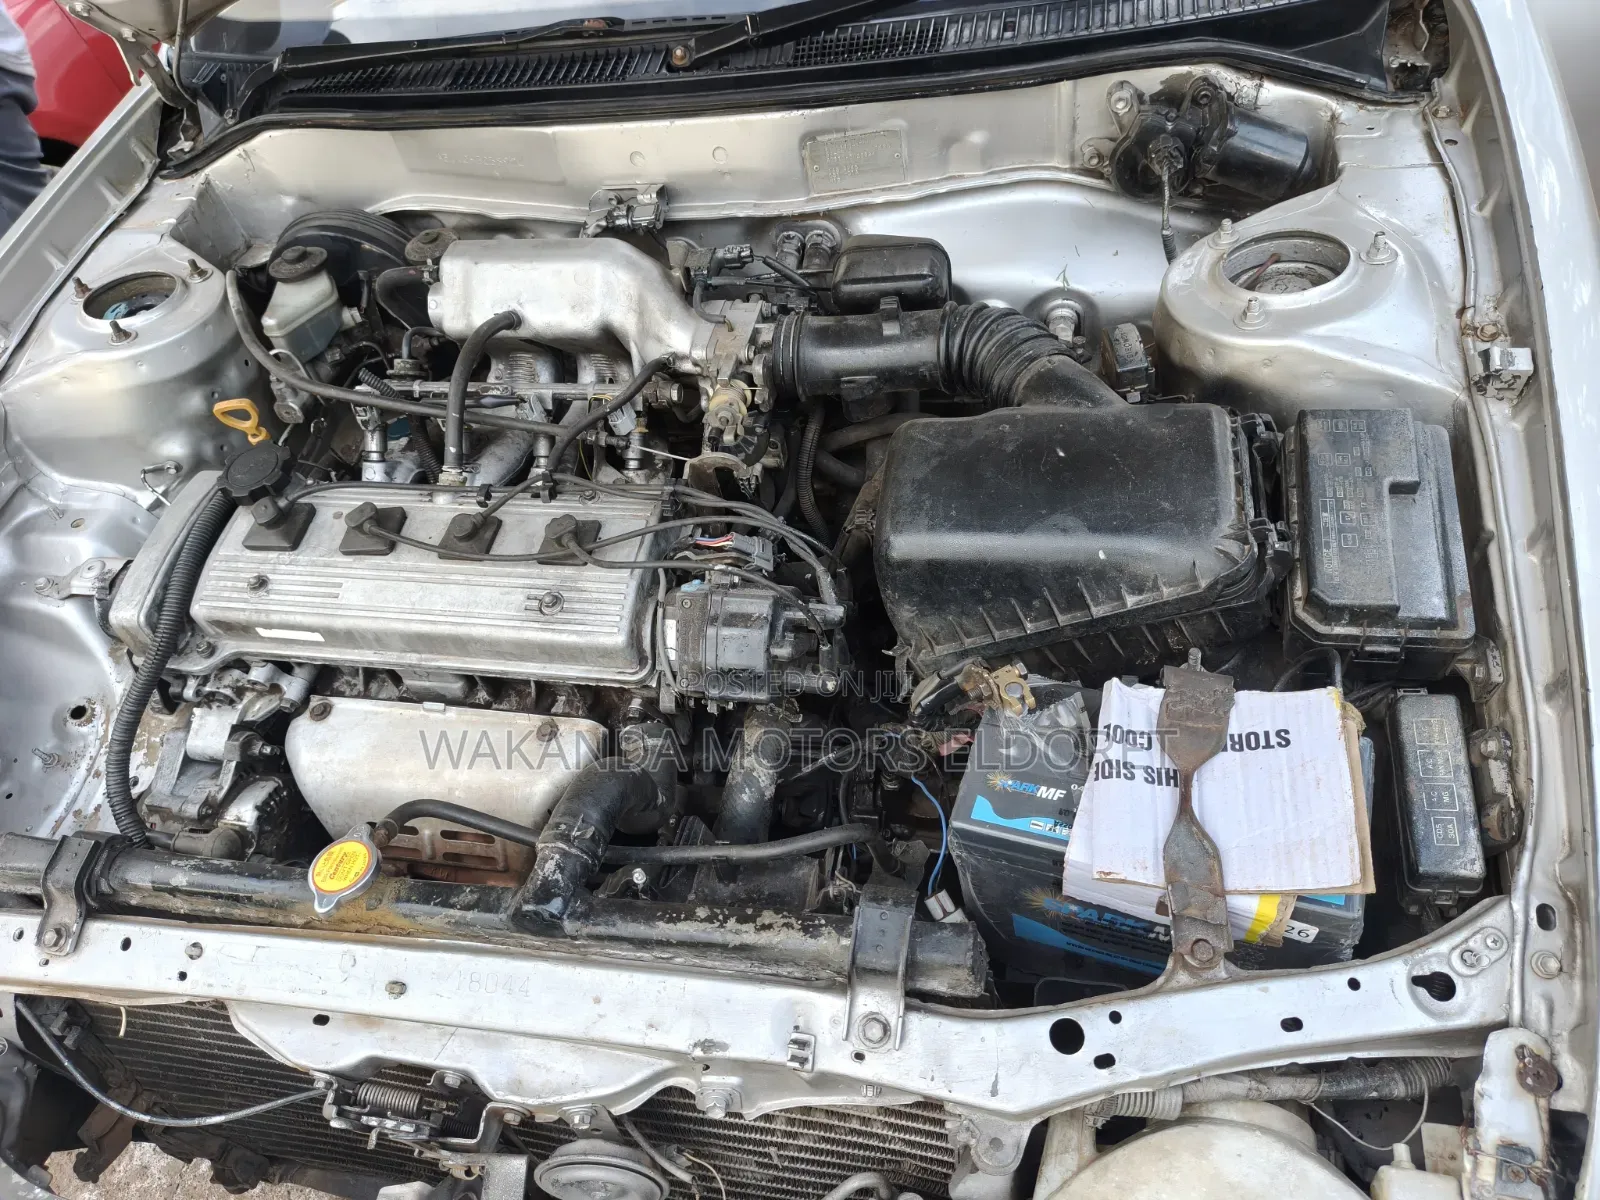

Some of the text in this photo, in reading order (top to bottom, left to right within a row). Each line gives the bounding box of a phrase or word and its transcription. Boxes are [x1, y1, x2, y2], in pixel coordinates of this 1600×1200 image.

[1221, 728, 1292, 753] STOR
[1143, 766, 1178, 788] HIS
[1441, 791, 1450, 803] MG
[1435, 823, 1444, 839] CDS
[1447, 823, 1456, 839] 30A
[329, 852, 348, 880] Century
